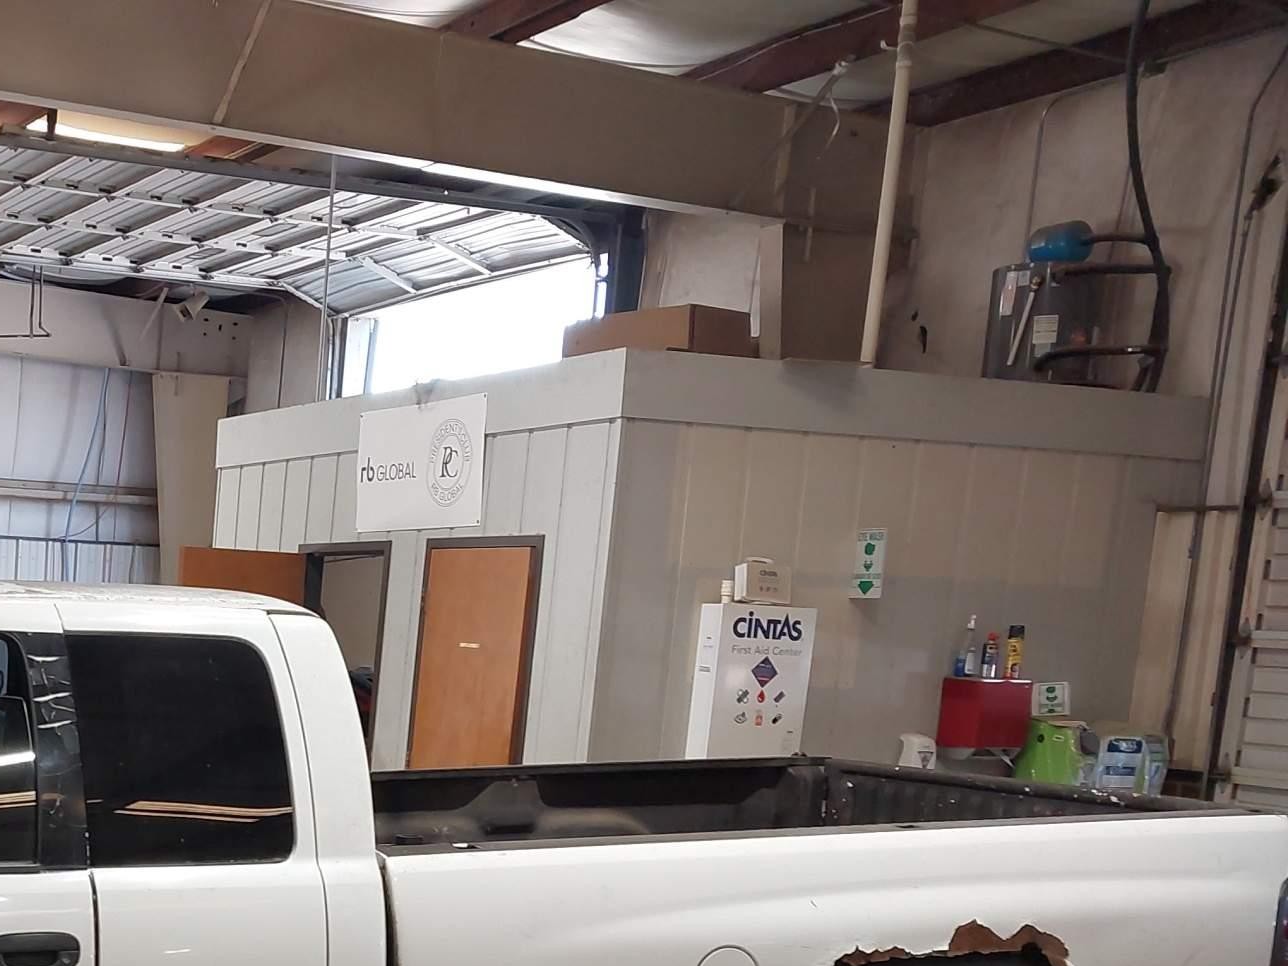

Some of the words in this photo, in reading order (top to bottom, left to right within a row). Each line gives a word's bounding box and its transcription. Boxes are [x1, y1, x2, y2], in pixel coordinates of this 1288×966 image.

[360, 457, 375, 483] rb
[376, 461, 416, 481] GLOBAL
[732, 645, 752, 655] First
[754, 646, 769, 655] Aid
[772, 647, 802, 656] Center
